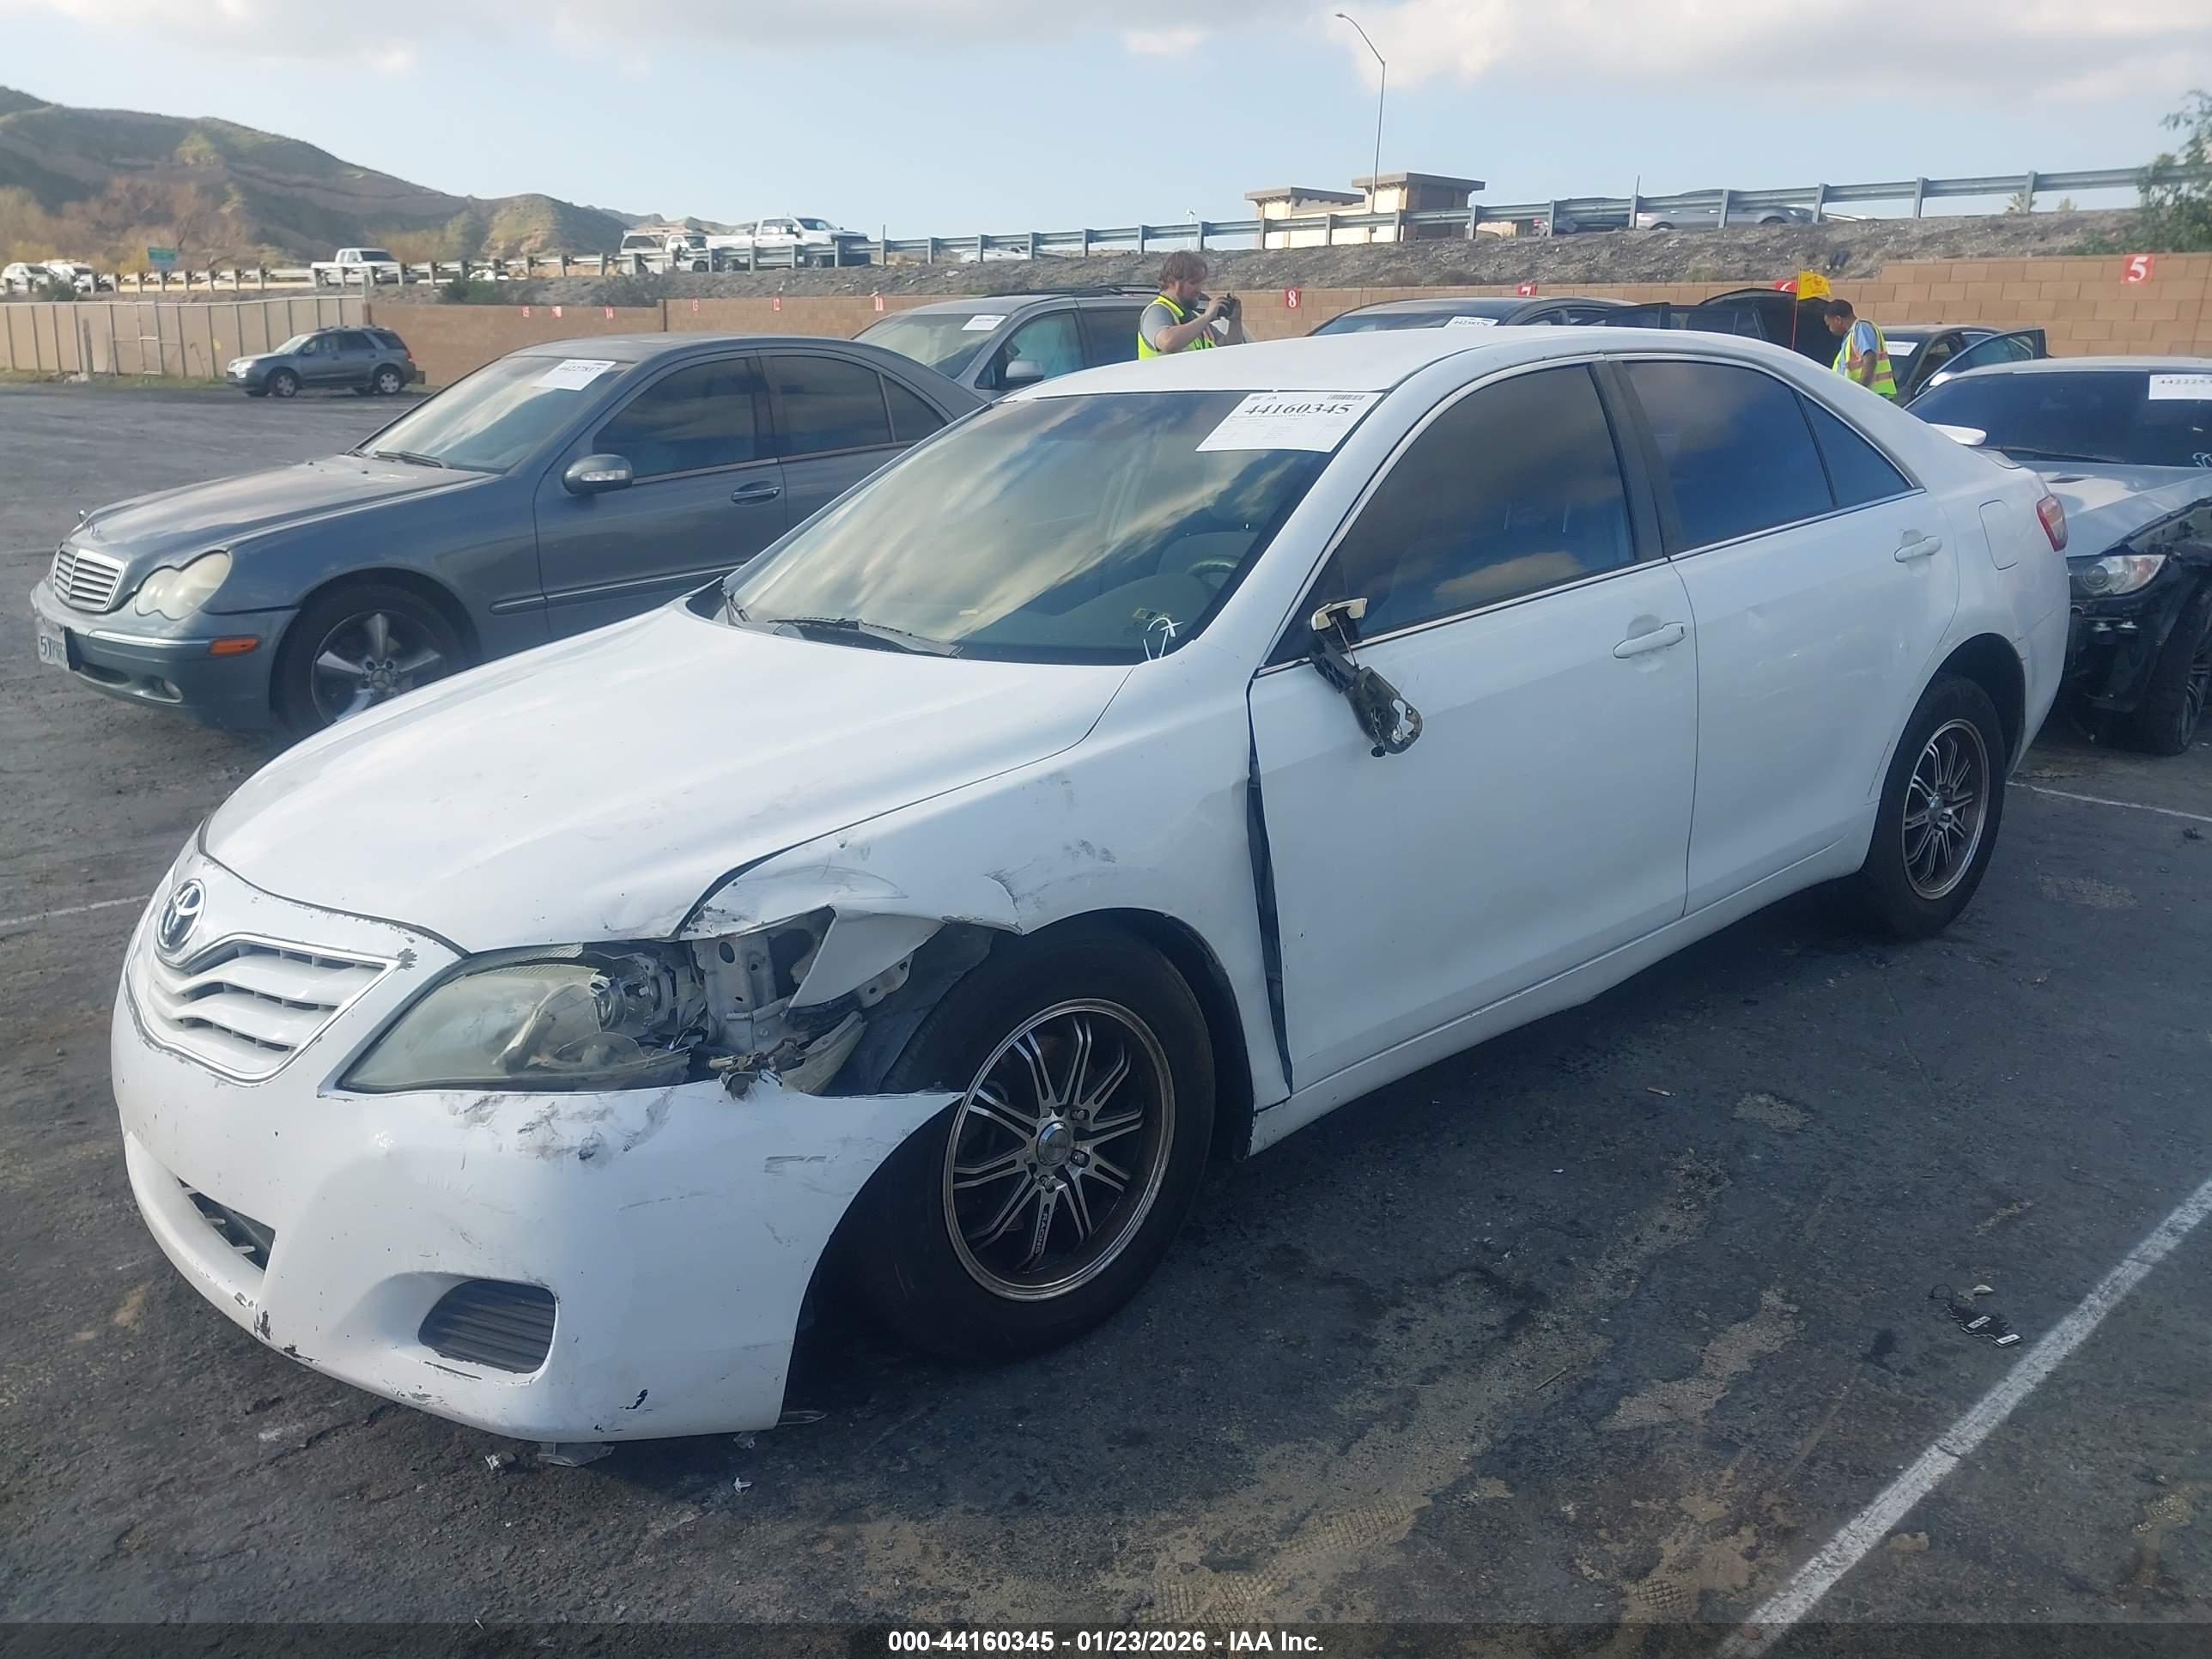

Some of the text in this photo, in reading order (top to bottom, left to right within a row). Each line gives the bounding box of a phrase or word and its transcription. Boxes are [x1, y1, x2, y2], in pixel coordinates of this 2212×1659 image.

[2128, 257, 2148, 282] 5
[874, 297, 884, 312] 11
[1288, 289, 1297, 308] 8
[1244, 403, 1354, 415] 44160345
[1035, 1212, 1048, 1255] RACING
